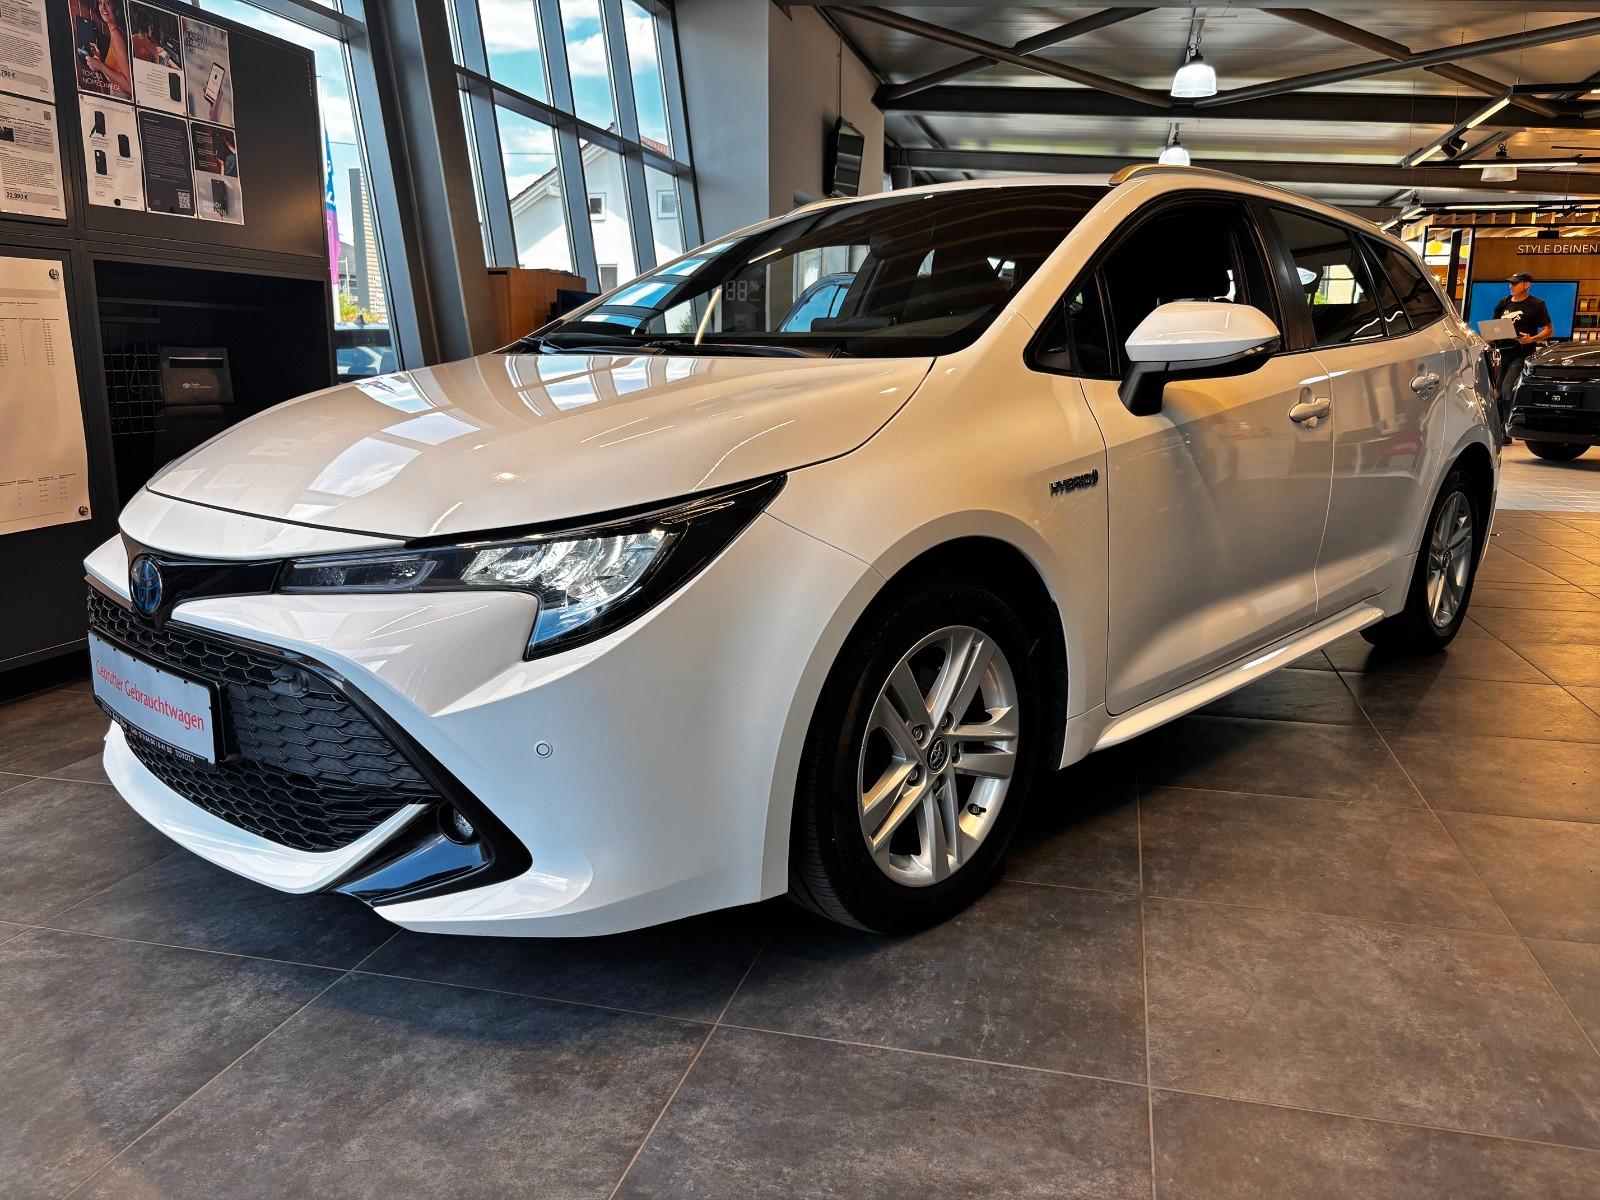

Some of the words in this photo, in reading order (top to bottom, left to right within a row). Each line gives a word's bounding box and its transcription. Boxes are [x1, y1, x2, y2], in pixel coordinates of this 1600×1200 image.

[1517, 244, 1551, 254] STYLE
[1553, 244, 1598, 254] DEINEN
[1049, 472, 1091, 497] HYBRID
[125, 680, 204, 731] Gebrauchtwagen
